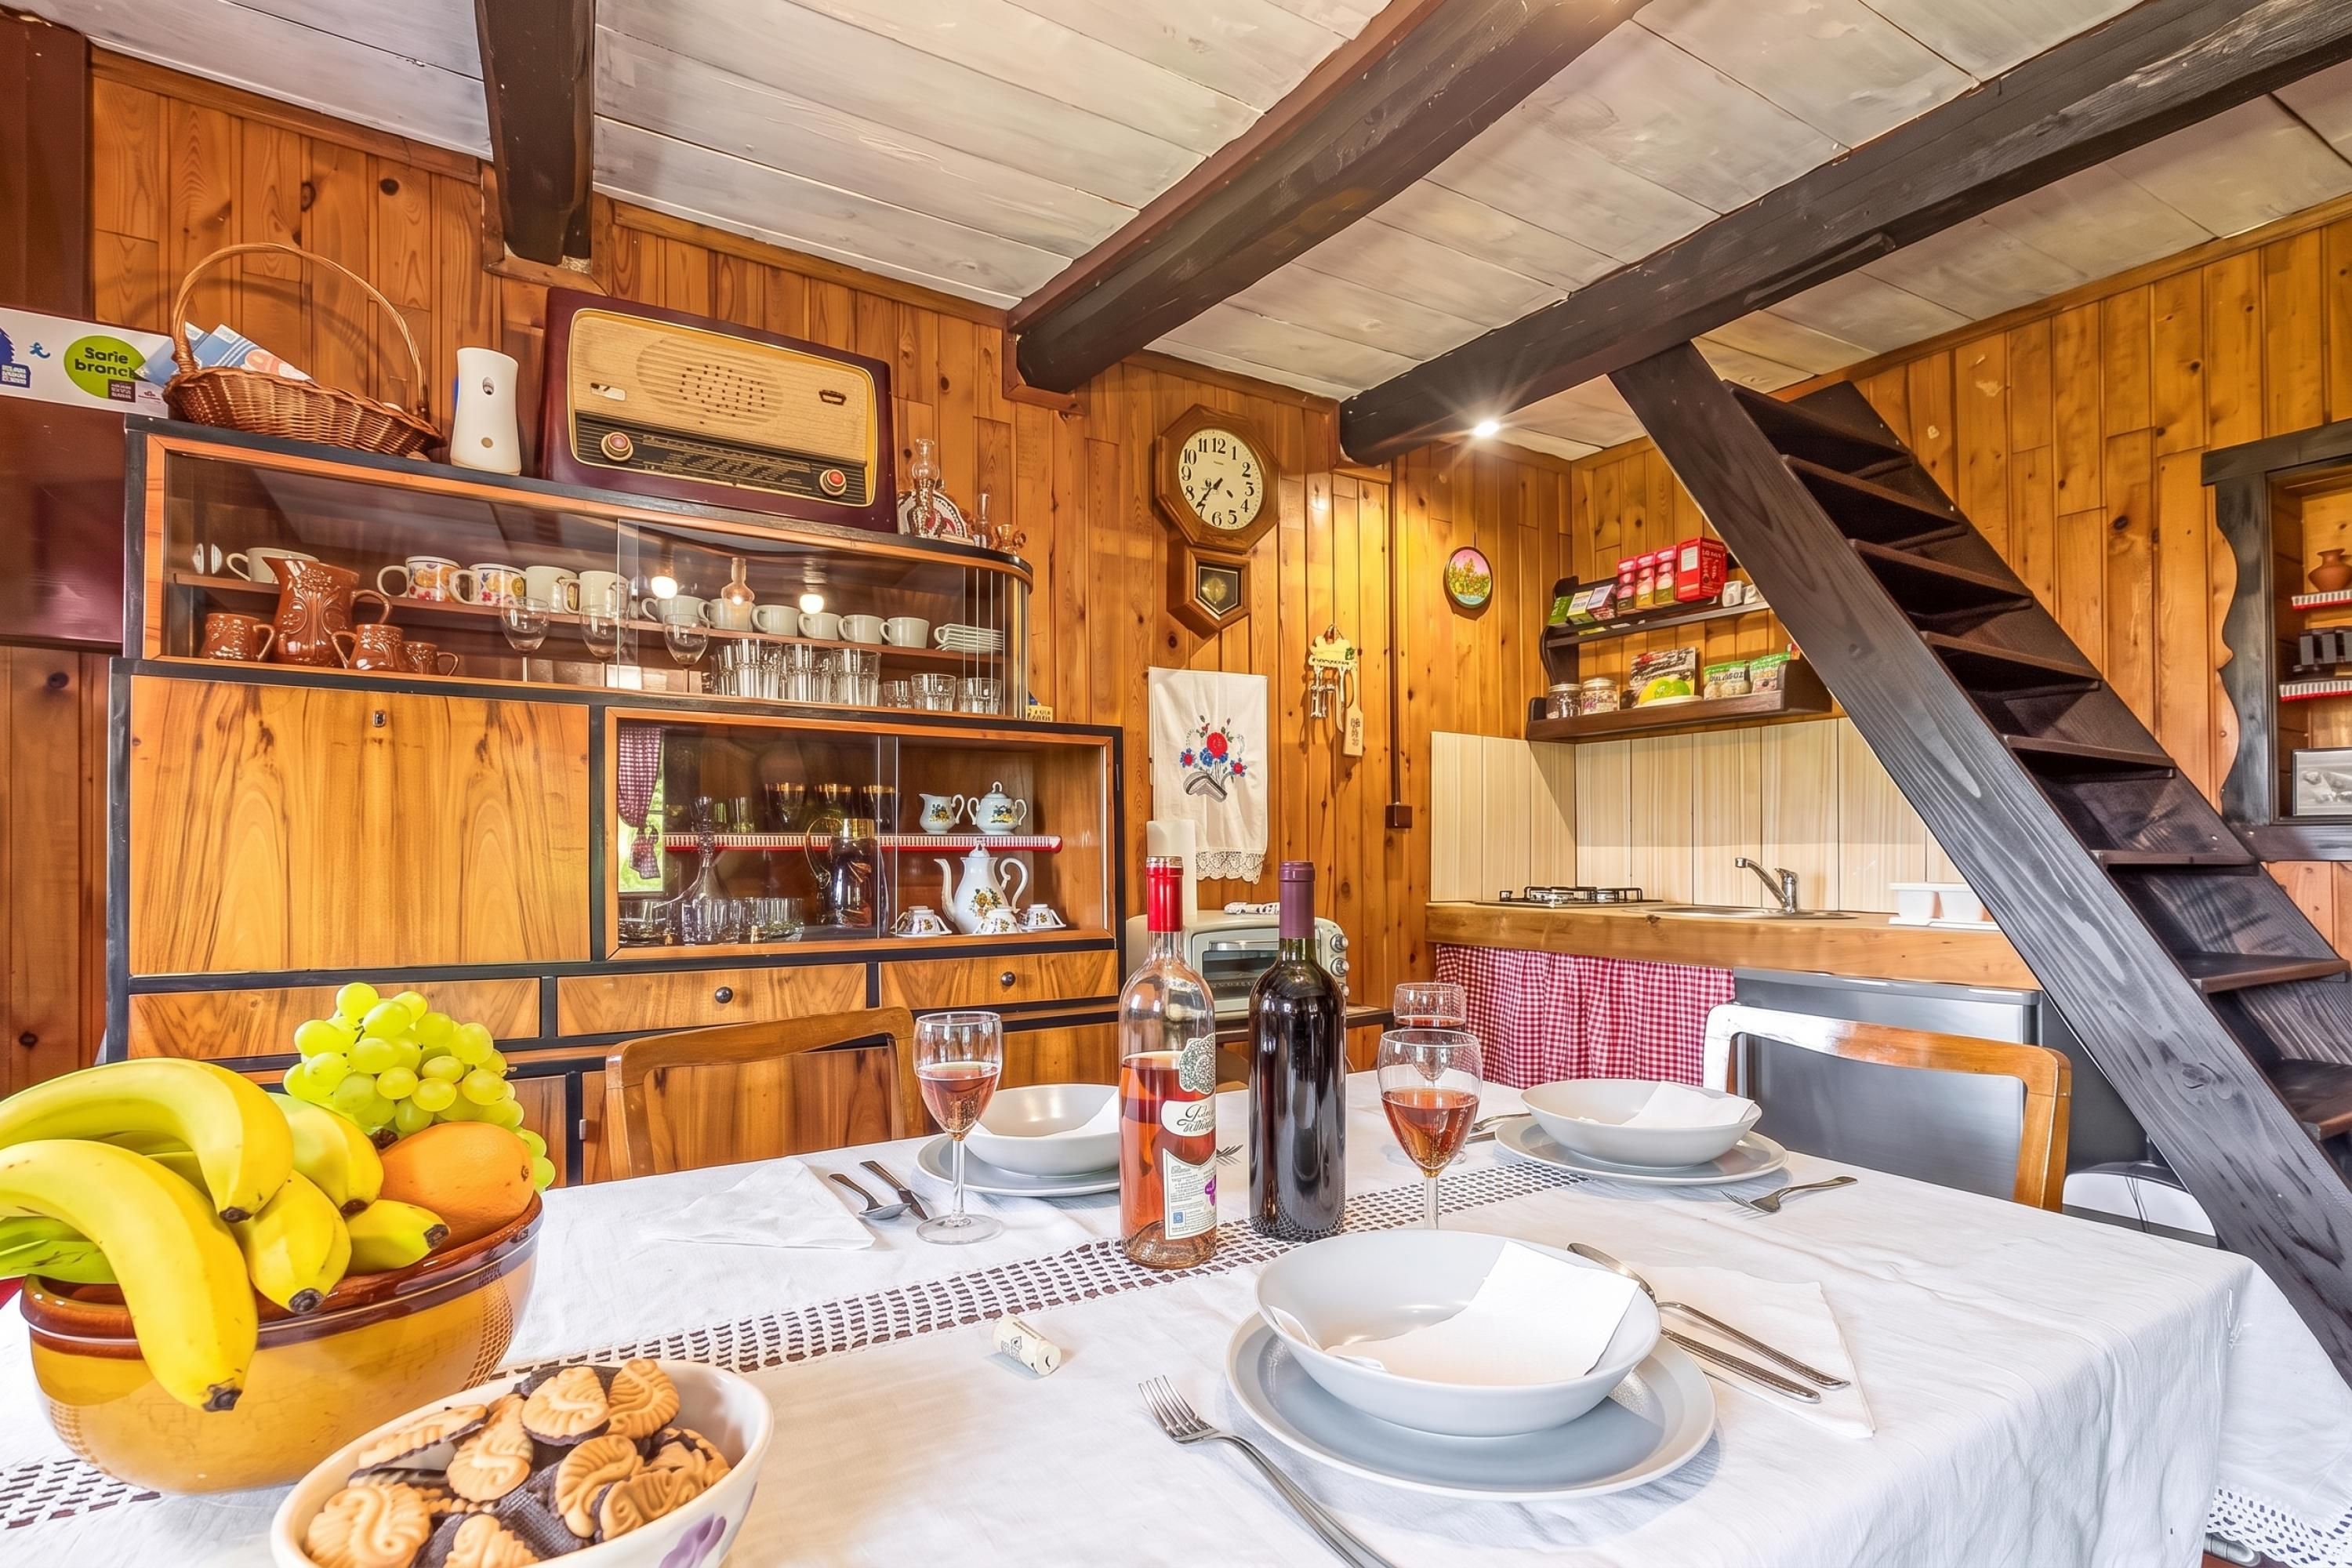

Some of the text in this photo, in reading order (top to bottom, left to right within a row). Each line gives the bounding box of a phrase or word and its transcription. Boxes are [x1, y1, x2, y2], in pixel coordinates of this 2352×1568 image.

[85, 347, 129, 364] Sarie
[1198, 437, 1208, 453] 11
[1212, 437, 1226, 454] 12
[1232, 445, 1236, 460] 1
[1183, 448, 1197, 465] 10
[1181, 465, 1191, 481] 9
[1242, 462, 1251, 477] 2
[1185, 485, 1195, 501] 8
[1240, 499, 1249, 513] 4
[1212, 511, 1221, 526] 6
[1228, 509, 1237, 524] 5
